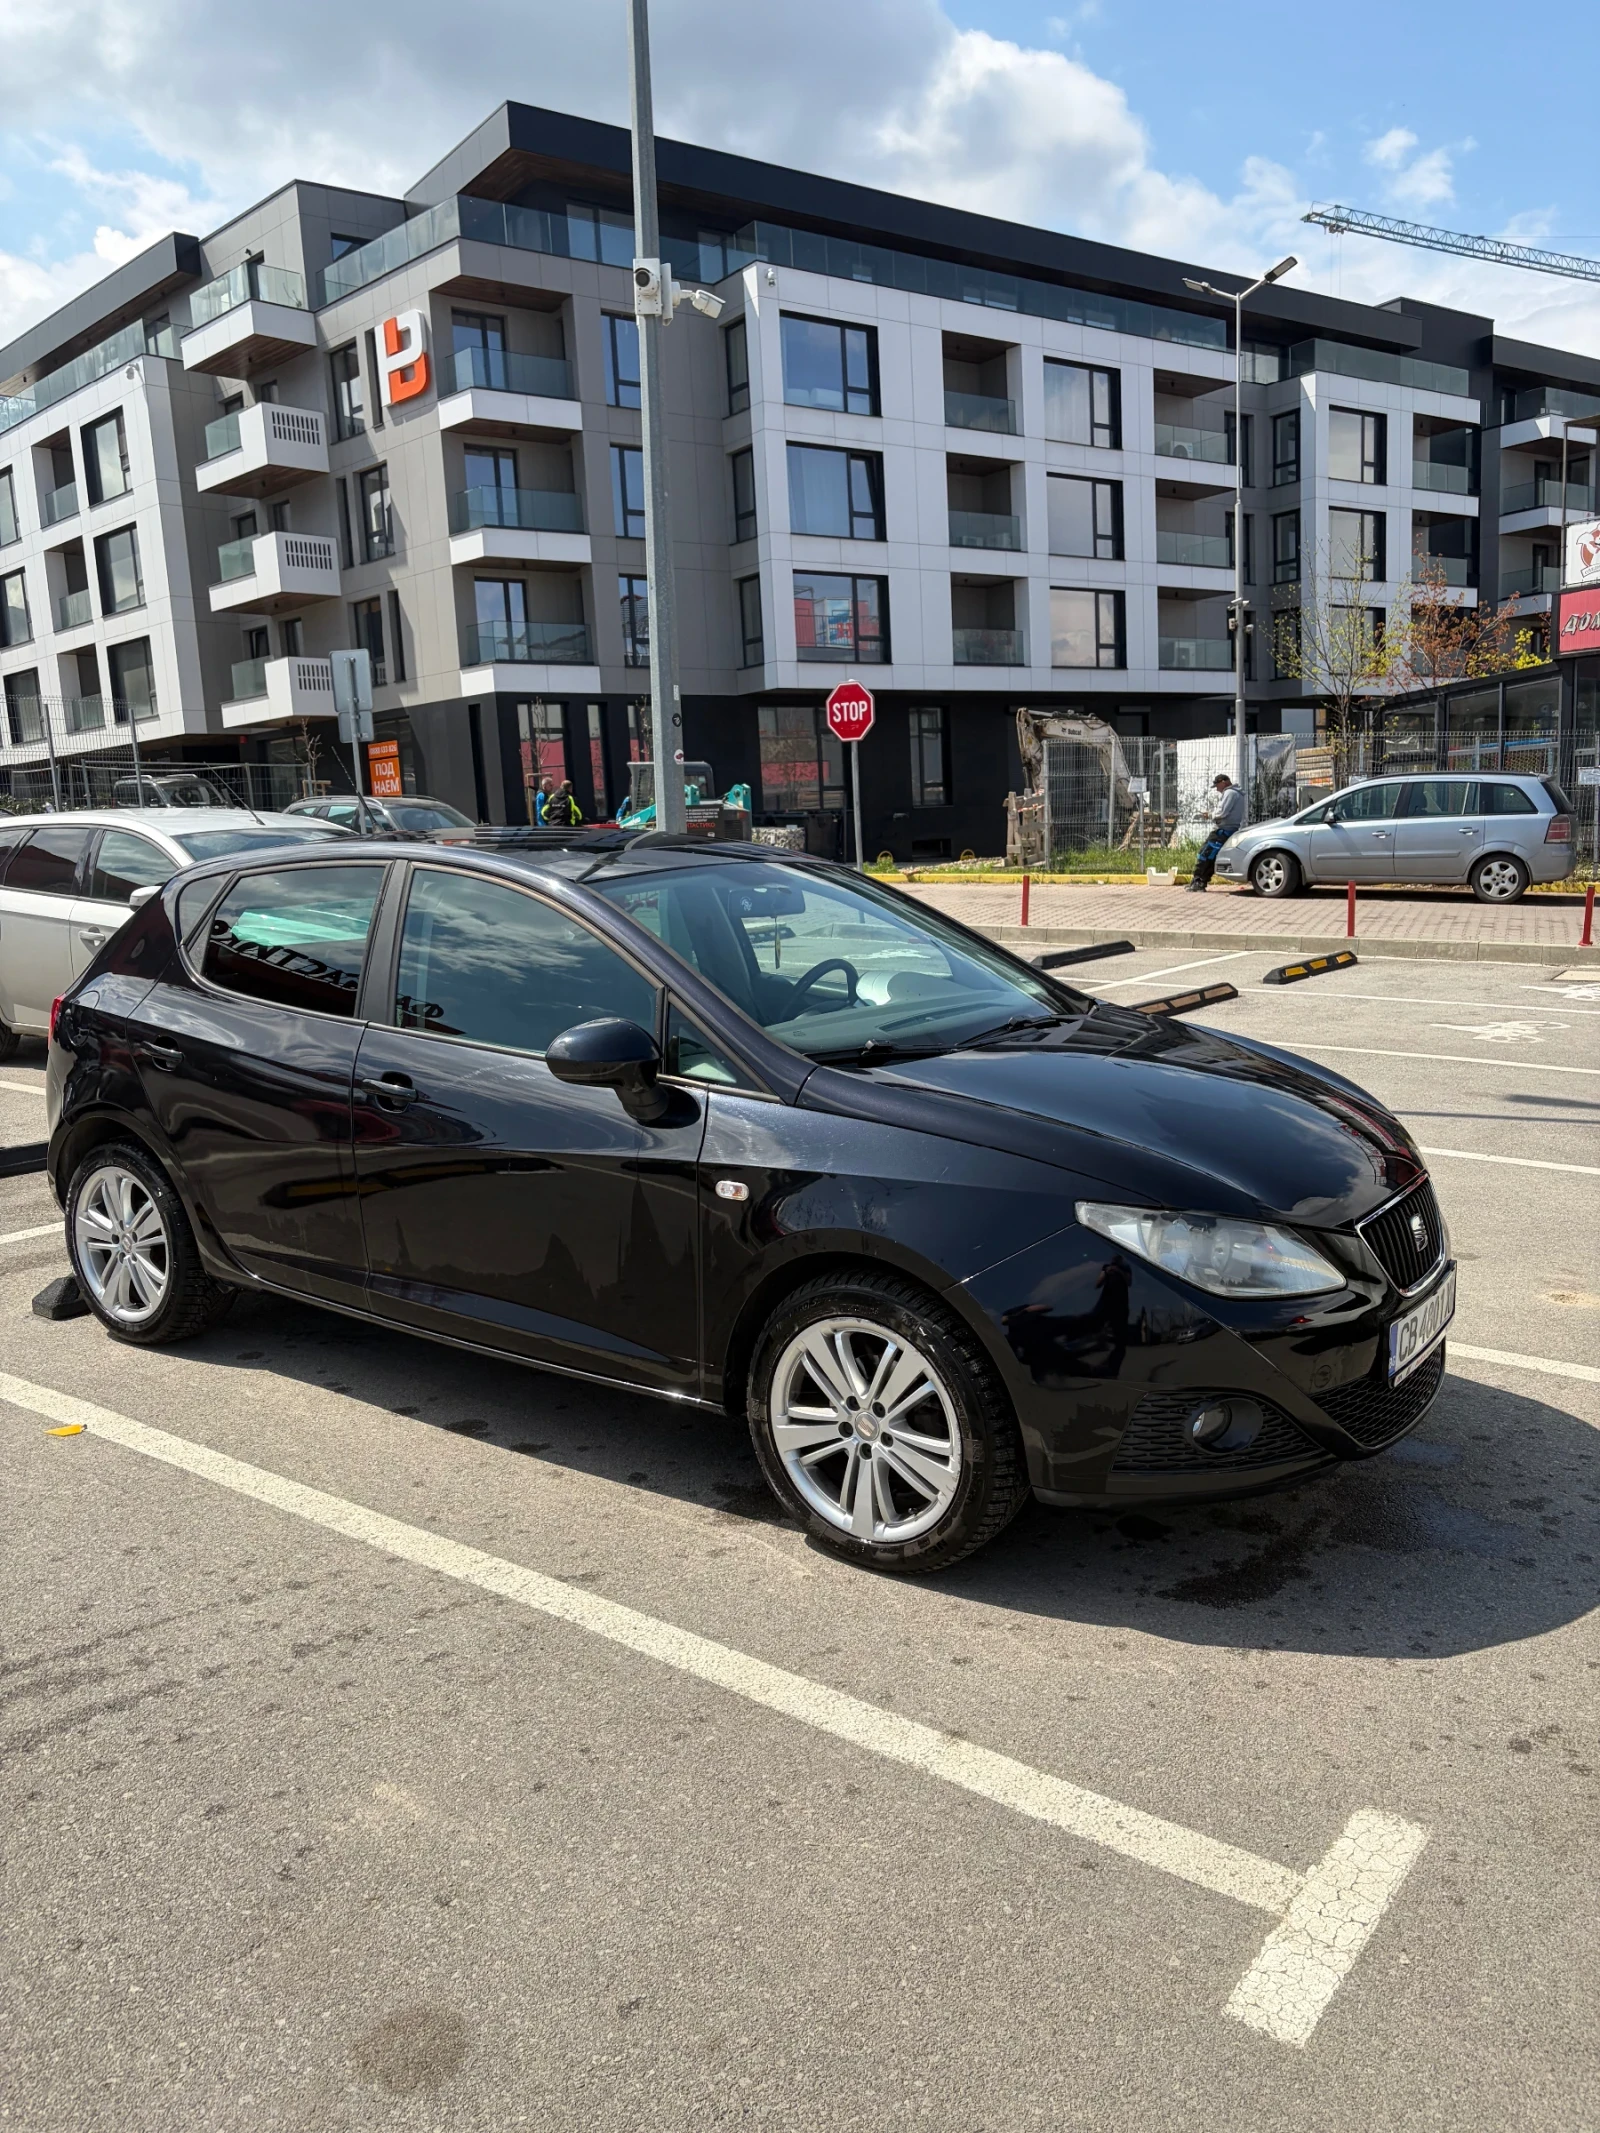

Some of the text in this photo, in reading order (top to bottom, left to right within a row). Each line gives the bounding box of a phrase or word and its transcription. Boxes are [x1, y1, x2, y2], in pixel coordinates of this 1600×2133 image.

[833, 701, 868, 723] STOP
[375, 762, 395, 777] ПОД
[373, 777, 400, 794] НАЕМ
[1399, 1316, 1418, 1362] CB
